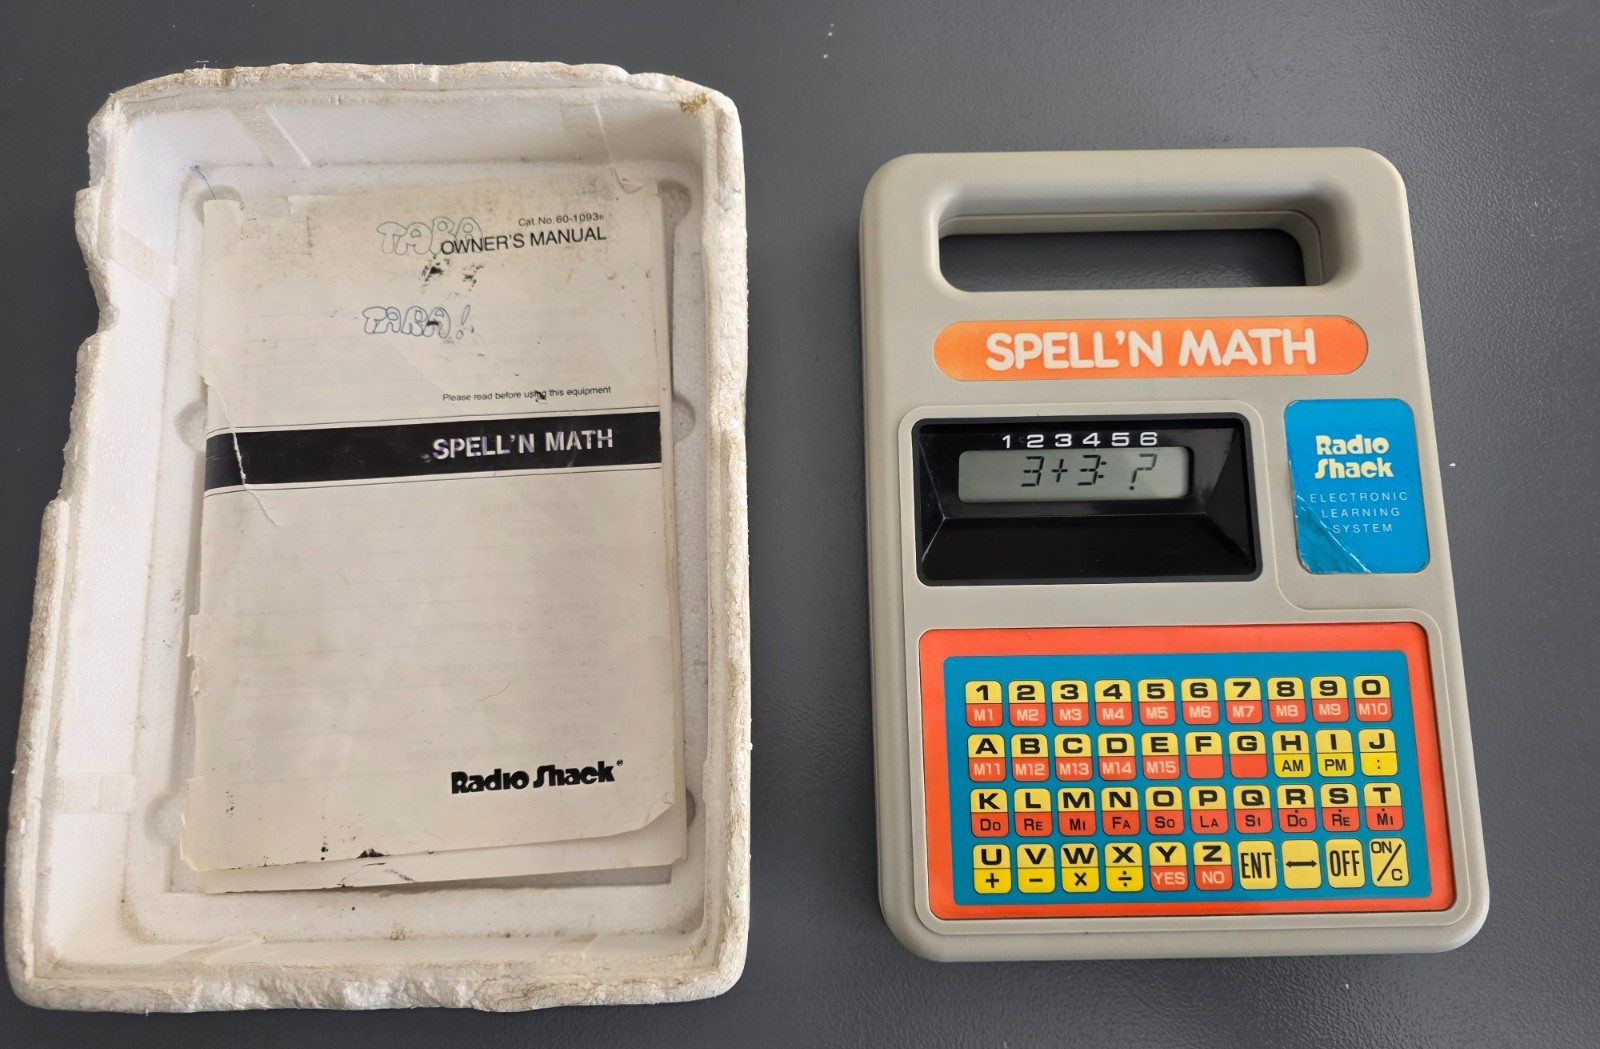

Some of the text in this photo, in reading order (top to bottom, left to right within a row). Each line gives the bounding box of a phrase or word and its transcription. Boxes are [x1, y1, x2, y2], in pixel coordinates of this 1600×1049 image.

[377, 216, 484, 255] TARA
[441, 226, 607, 256] OWNER'S MANUAL
[985, 328, 1316, 371] SPELL'N MATH
[442, 386, 612, 402] Please read before using this equipment
[432, 428, 614, 460] SPELL'N MATH
[1002, 432, 1158, 448] 1 2 3 4 5 6
[1315, 434, 1390, 455] Radio
[1129, 453, 1157, 490] ?
[1314, 457, 1395, 479] Shack
[1310, 491, 1408, 503] ELECTRONIC
[1321, 507, 1400, 518] LEARNING
[1332, 523, 1393, 534] SYSTEM
[976, 680, 1381, 700] 1 2 3 4 5 6 7 8 9 0
[974, 703, 1388, 721] M1 M2 M3 M4 M5 M6 M7 M8 M9 M10
[975, 733, 1385, 754] A B C D E F G H I J
[974, 763, 1000, 776] M11
[1016, 763, 1045, 776] M12
[1059, 763, 1089, 775] M13
[1102, 762, 1132, 774] M14
[1146, 761, 1177, 773] M15
[1282, 760, 1304, 772] AM
[1325, 759, 1346, 771] PM
[451, 768, 529, 794] Radio
[979, 787, 1391, 810] K L M N O P Q R S T
[981, 849, 1002, 865] U
[1025, 848, 1047, 864] V
[1063, 848, 1095, 864] W
[1112, 847, 1135, 863] X
[1155, 846, 1177, 862] Y
[1203, 846, 1222, 862] Z
[1240, 852, 1272, 878] ENT
[1329, 851, 1359, 877] OFF
[1152, 872, 1185, 884] YES
[1202, 871, 1224, 884] NO
